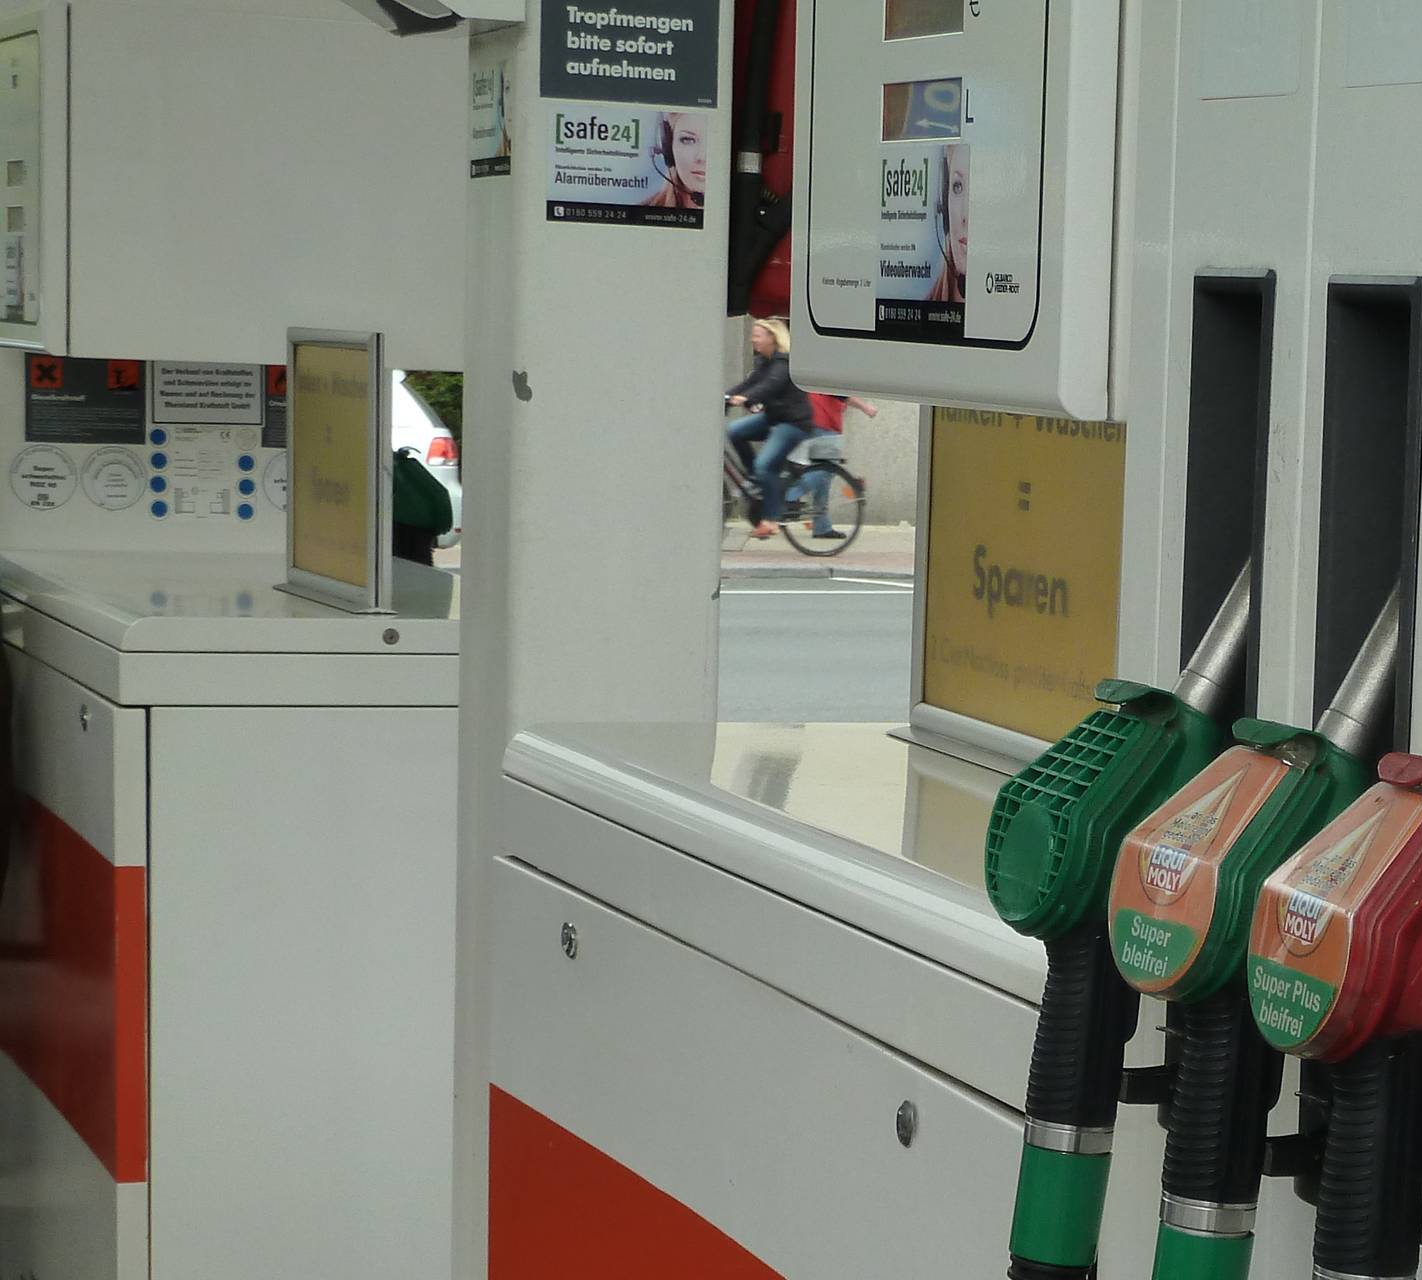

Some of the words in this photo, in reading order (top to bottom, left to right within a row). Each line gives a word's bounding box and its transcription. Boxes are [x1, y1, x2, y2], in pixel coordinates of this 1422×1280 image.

[566, 6, 694, 34] Tropfmengen
[567, 31, 611, 51] bitte
[615, 36, 674, 55] sofort
[566, 58, 676, 81] aufnehmen
[965, 88, 975, 123] L
[554, 171, 649, 189] Alarmüberwacht!
[972, 544, 1069, 619] Sparen
[1151, 846, 1187, 870] LIQUI
[1146, 866, 1181, 891] MOLY
[1288, 891, 1321, 919] LIQUI
[1131, 915, 1172, 947] Super
[1284, 912, 1316, 942] MOLY
[1121, 940, 1169, 977] bleifrei
[1253, 965, 1292, 999] Super
[1292, 979, 1322, 1013] Plus
[1259, 999, 1304, 1038] bleifrei
